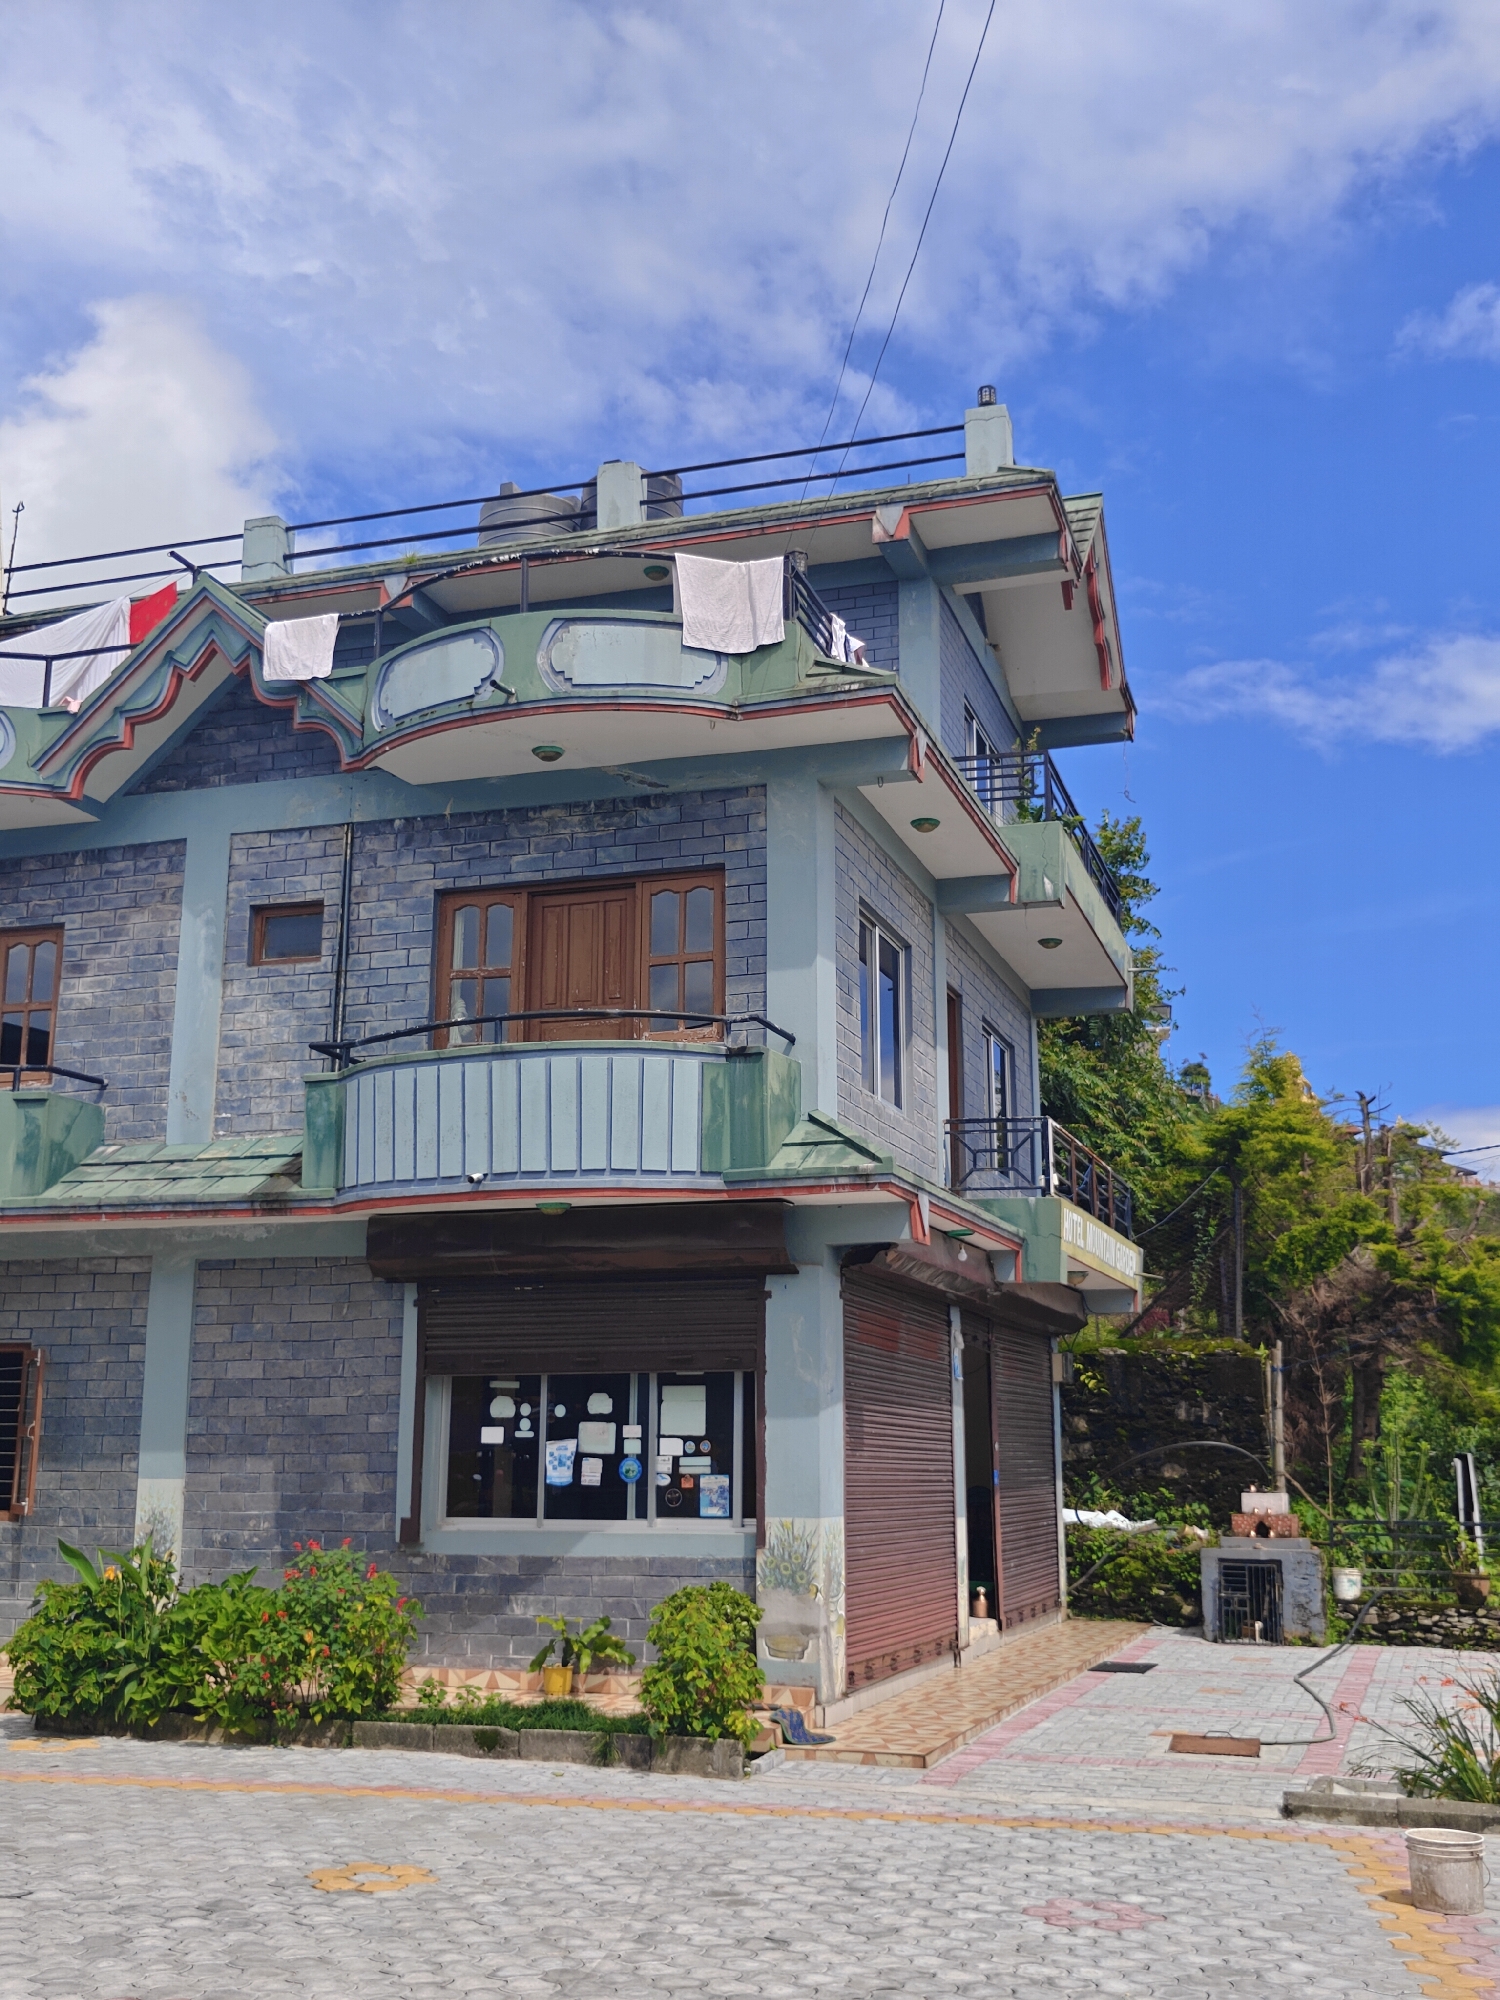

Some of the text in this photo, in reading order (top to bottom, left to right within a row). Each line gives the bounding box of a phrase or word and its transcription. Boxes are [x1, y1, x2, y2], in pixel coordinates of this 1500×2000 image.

[1063, 1207, 1137, 1278] HOTEL MOUNTAIN GARDEN
